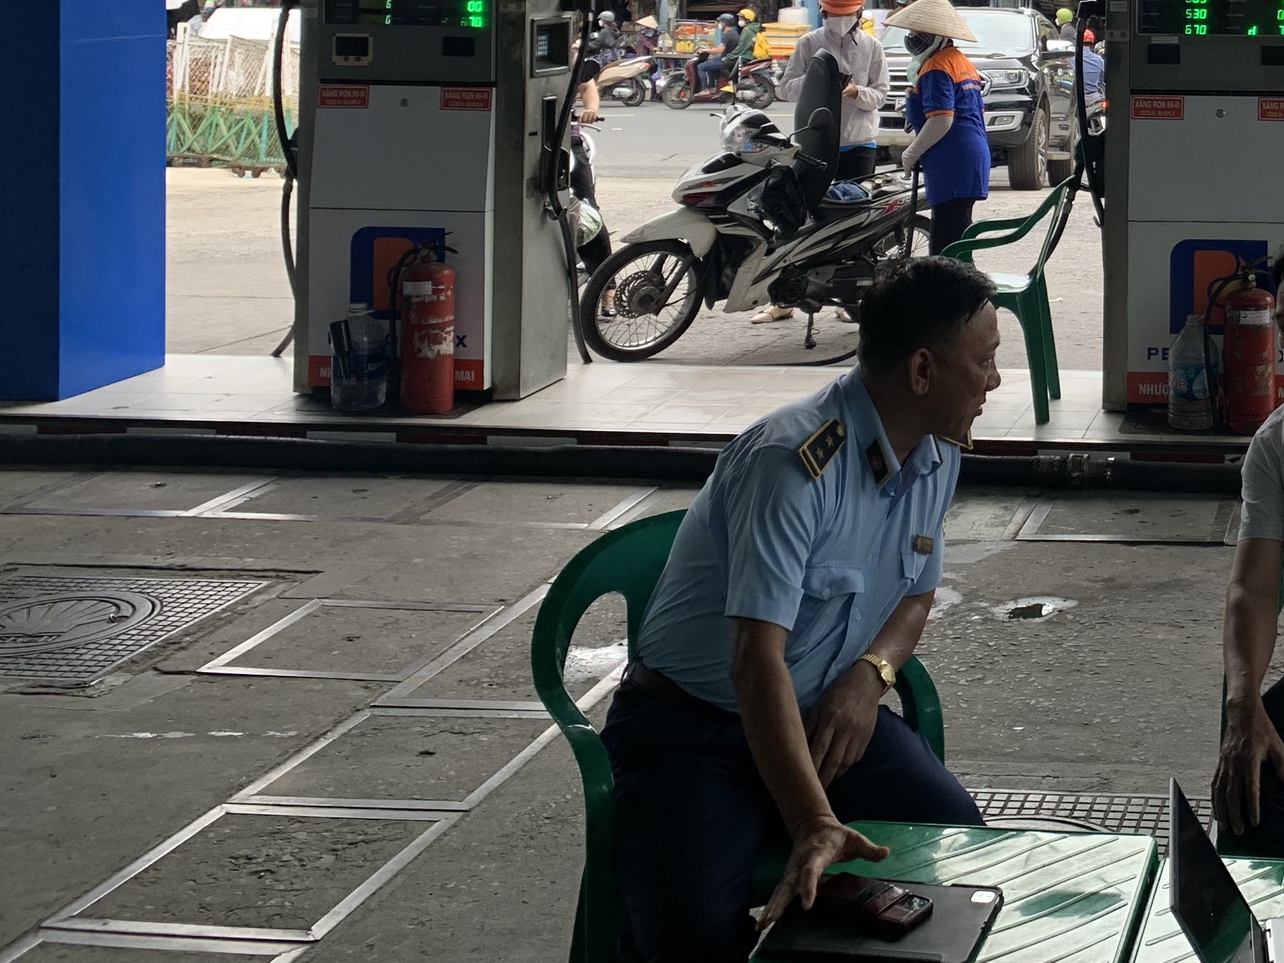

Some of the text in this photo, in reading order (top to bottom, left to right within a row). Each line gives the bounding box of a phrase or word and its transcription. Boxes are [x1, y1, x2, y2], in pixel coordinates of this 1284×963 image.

[467, 0, 482, 12] 00
[1185, 8, 1207, 20] 530
[469, 16, 483, 28] 70
[1184, 24, 1207, 35] 670
[1152, 101, 1166, 109] RON
